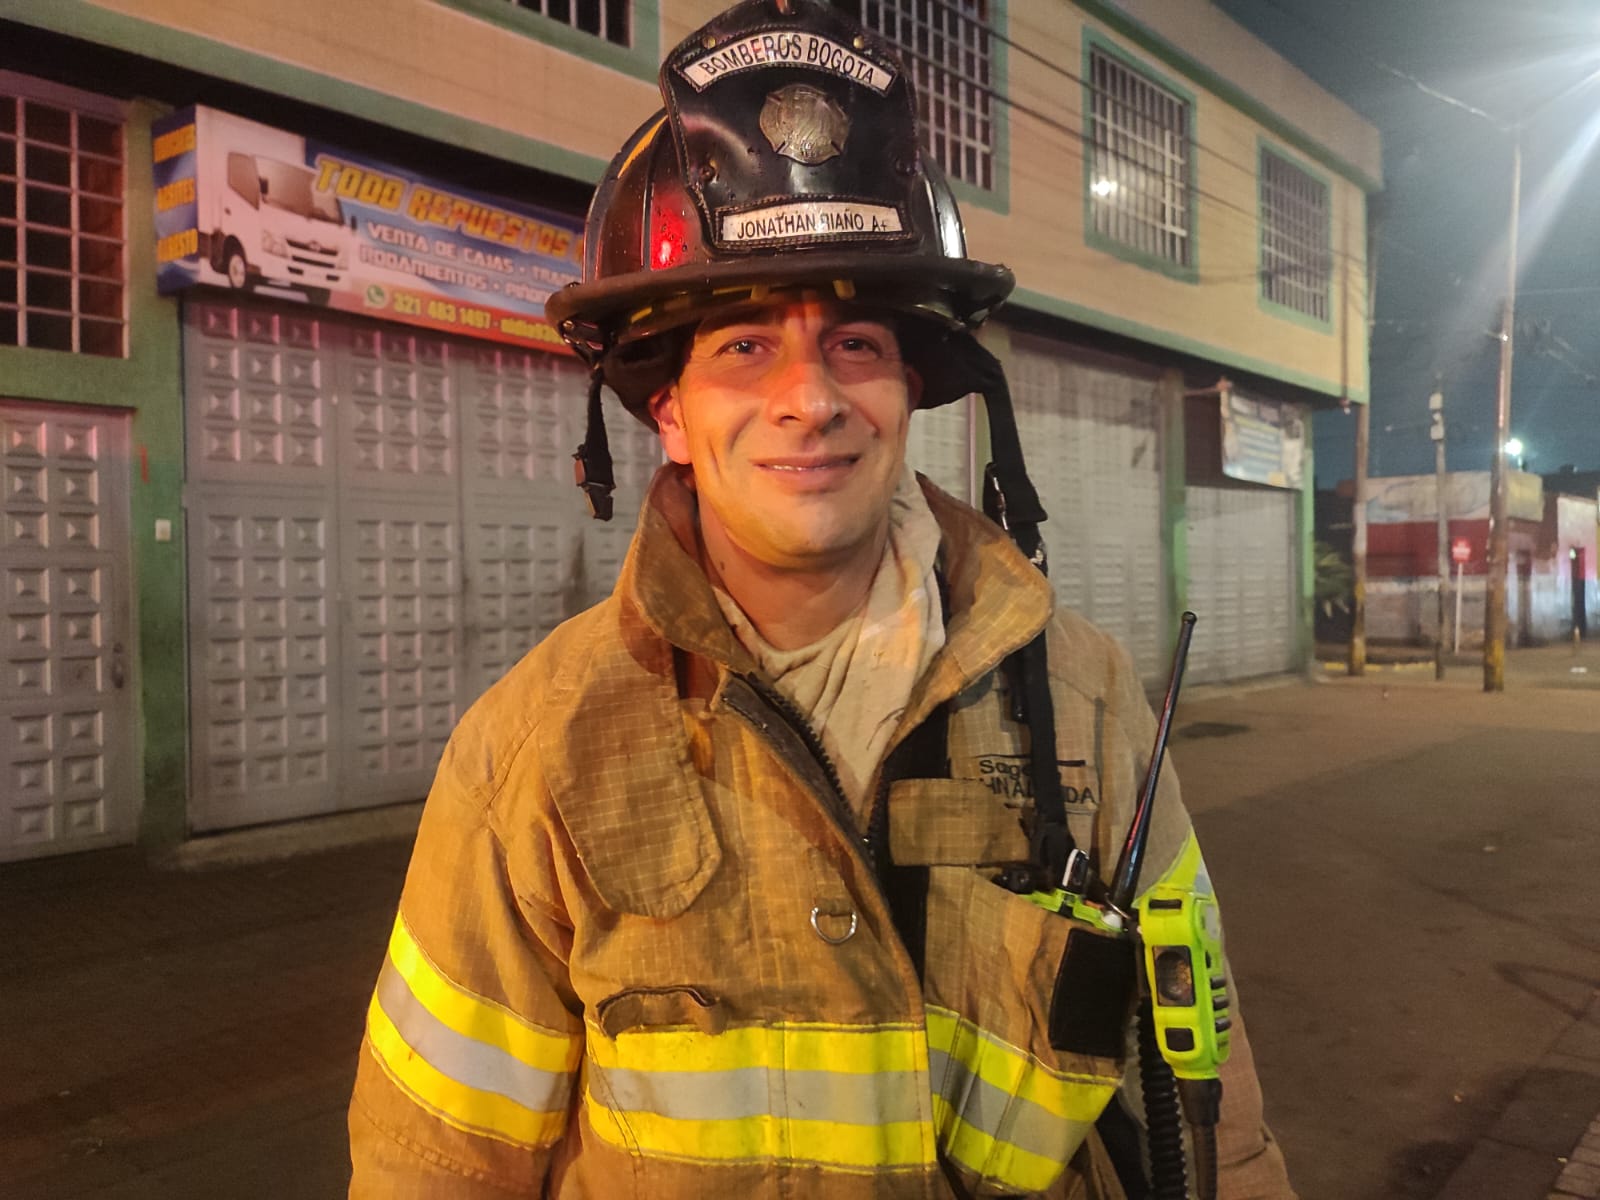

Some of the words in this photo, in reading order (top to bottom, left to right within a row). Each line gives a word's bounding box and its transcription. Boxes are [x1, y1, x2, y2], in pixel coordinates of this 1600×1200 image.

[698, 34, 802, 76] BOMBEROS
[806, 36, 875, 84] BOGOTA
[316, 158, 406, 210] TODO
[408, 185, 572, 258] REPUESTOS
[737, 212, 816, 239] JONATHAN
[367, 220, 429, 253] VENTA
[434, 240, 457, 259] DE
[359, 244, 488, 290] RODAMIENTOS
[394, 292, 421, 317] 321
